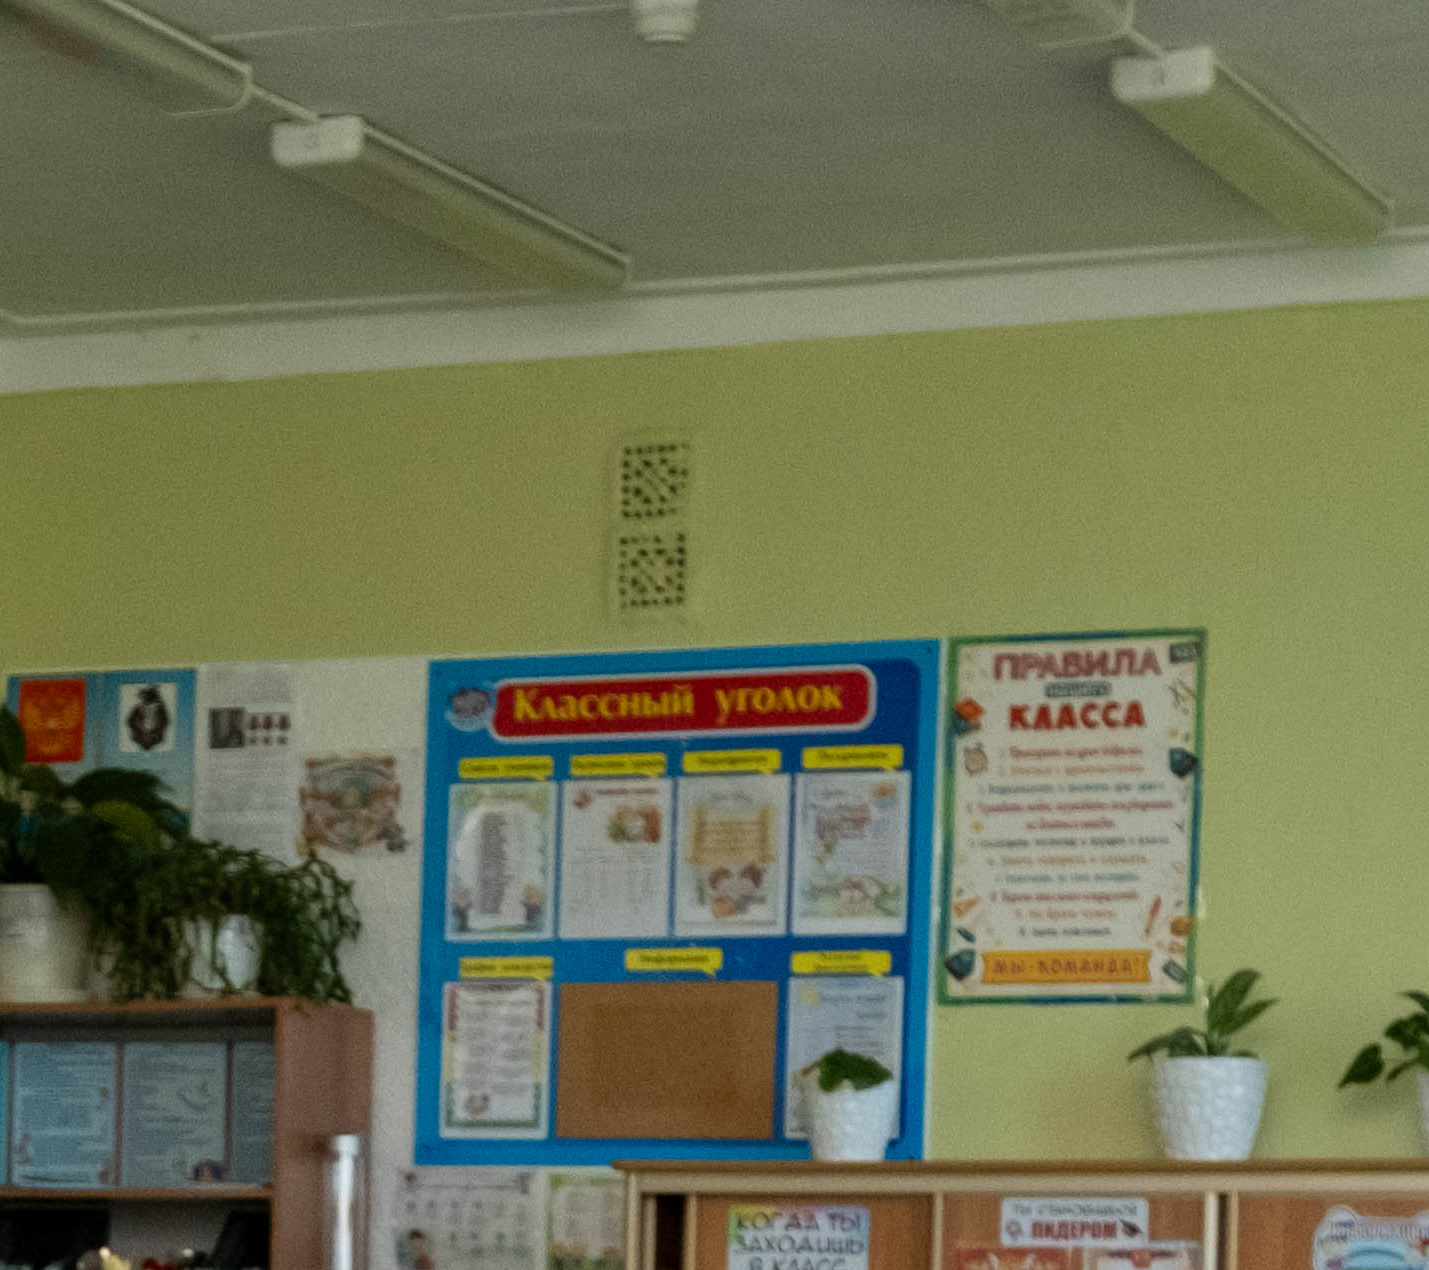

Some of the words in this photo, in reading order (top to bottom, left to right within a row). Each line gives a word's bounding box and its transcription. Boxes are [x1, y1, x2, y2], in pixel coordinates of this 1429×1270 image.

[992, 648, 1162, 682] ПРАВИЛА
[514, 684, 694, 721] Классный
[716, 684, 843, 727] уголок
[1009, 701, 1147, 731] КЛАССА
[735, 1209, 817, 1233] КОГДА
[823, 1208, 863, 1233] ТЫ
[1031, 1221, 1118, 1242] ЛИДЕРОМ
[733, 1233, 865, 1257] ЗАХОДИШЬ
